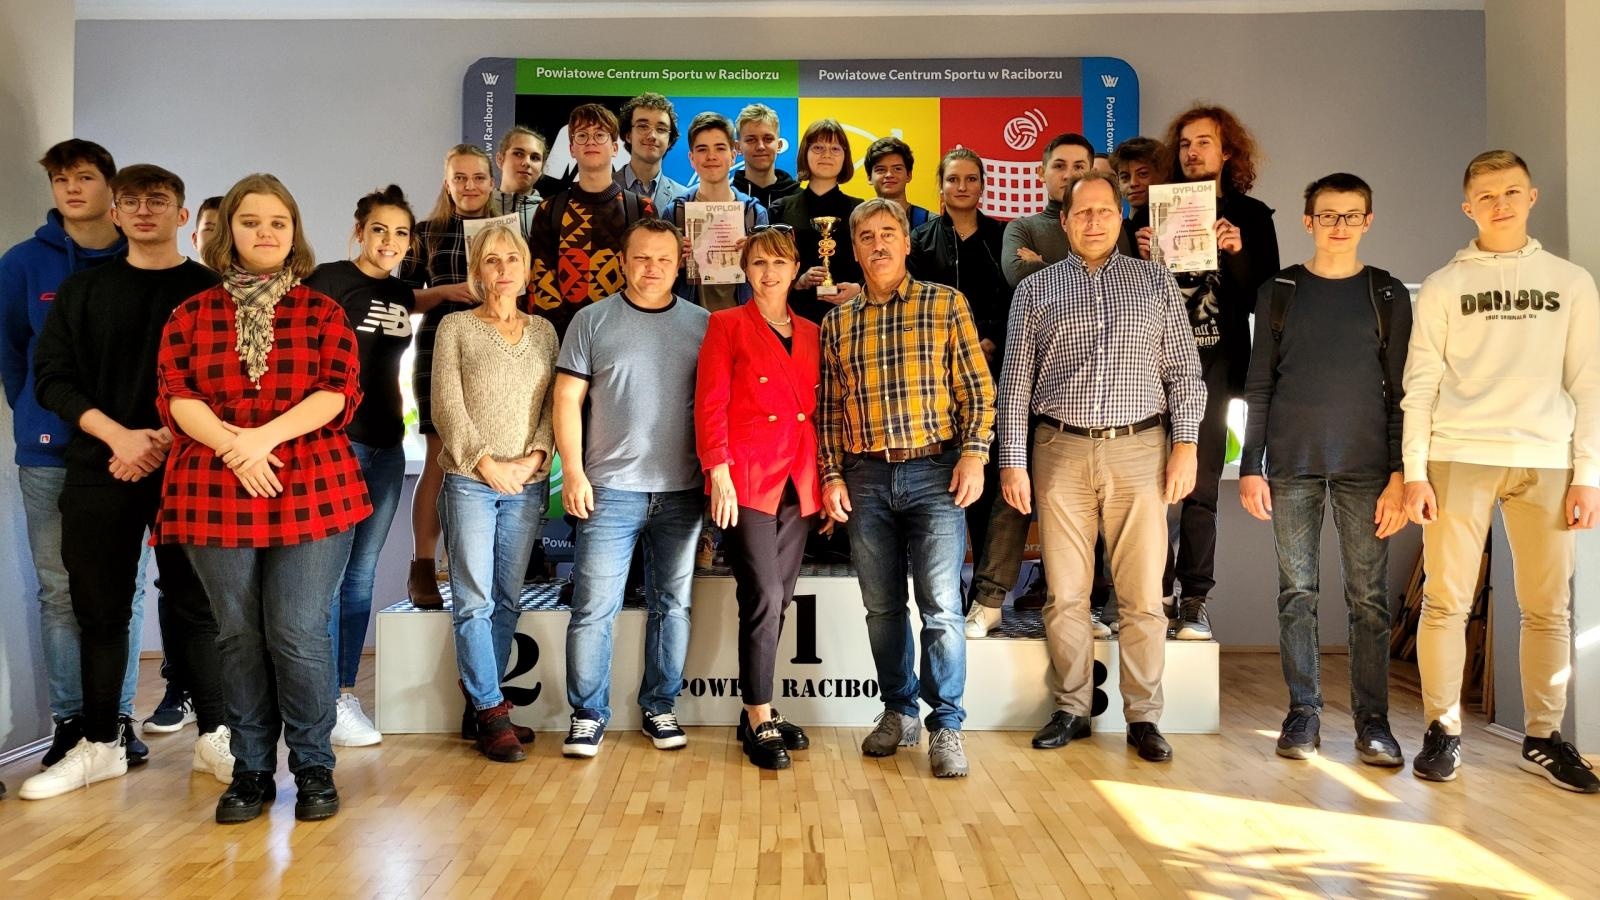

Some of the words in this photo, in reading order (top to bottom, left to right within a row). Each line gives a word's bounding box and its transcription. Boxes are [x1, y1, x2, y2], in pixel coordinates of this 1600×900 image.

[536, 67, 605, 78] Powiatowe
[607, 68, 660, 79] Centrum
[662, 69, 703, 81] Sportu
[705, 71, 717, 79] w
[719, 69, 779, 80] Raciborzu
[818, 69, 887, 80] Powiatowe
[889, 69, 942, 80] Centrum
[944, 69, 986, 82] Sportu
[988, 71, 999, 79] w
[1001, 69, 1063, 80] Raciborzu
[483, 91, 494, 141] Raciborzu
[1105, 96, 1116, 153] Powiatowe
[1172, 184, 1212, 195] DYPLOM
[705, 204, 741, 212] DYPLOM
[485, 215, 518, 227] DYPLOM
[542, 536, 575, 548] Powi
[791, 594, 823, 665] 1
[500, 632, 542, 707] 2
[676, 678, 743, 697] POWI
[781, 678, 879, 698] RACIBO
